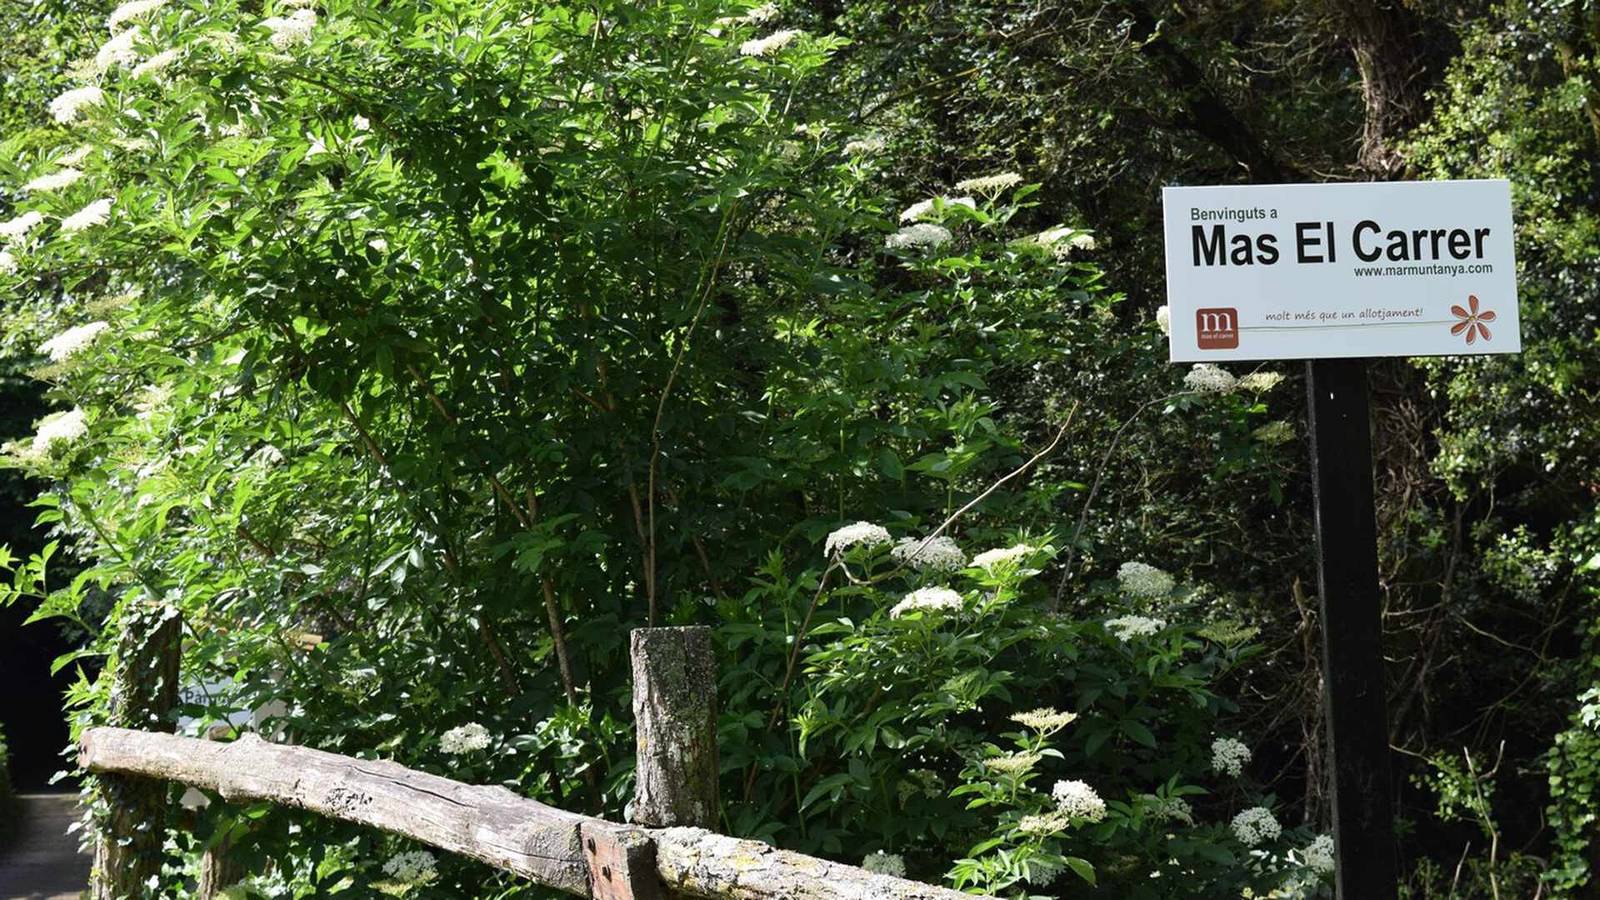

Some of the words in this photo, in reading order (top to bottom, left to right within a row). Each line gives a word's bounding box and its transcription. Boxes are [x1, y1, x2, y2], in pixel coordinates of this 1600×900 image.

[1191, 207, 1266, 223] Benvinguts
[1270, 208, 1278, 219] a
[1192, 224, 1280, 266] Mas
[1295, 221, 1336, 263] El
[1352, 219, 1491, 262] Carrer
[1354, 263, 1493, 277] www.marmuntanya.com
[1200, 312, 1233, 331] m
[1266, 310, 1290, 320] molt
[1295, 310, 1316, 320] més
[1319, 311, 1338, 322] que
[1341, 311, 1355, 319] un
[1359, 308, 1424, 320] allotjament!
